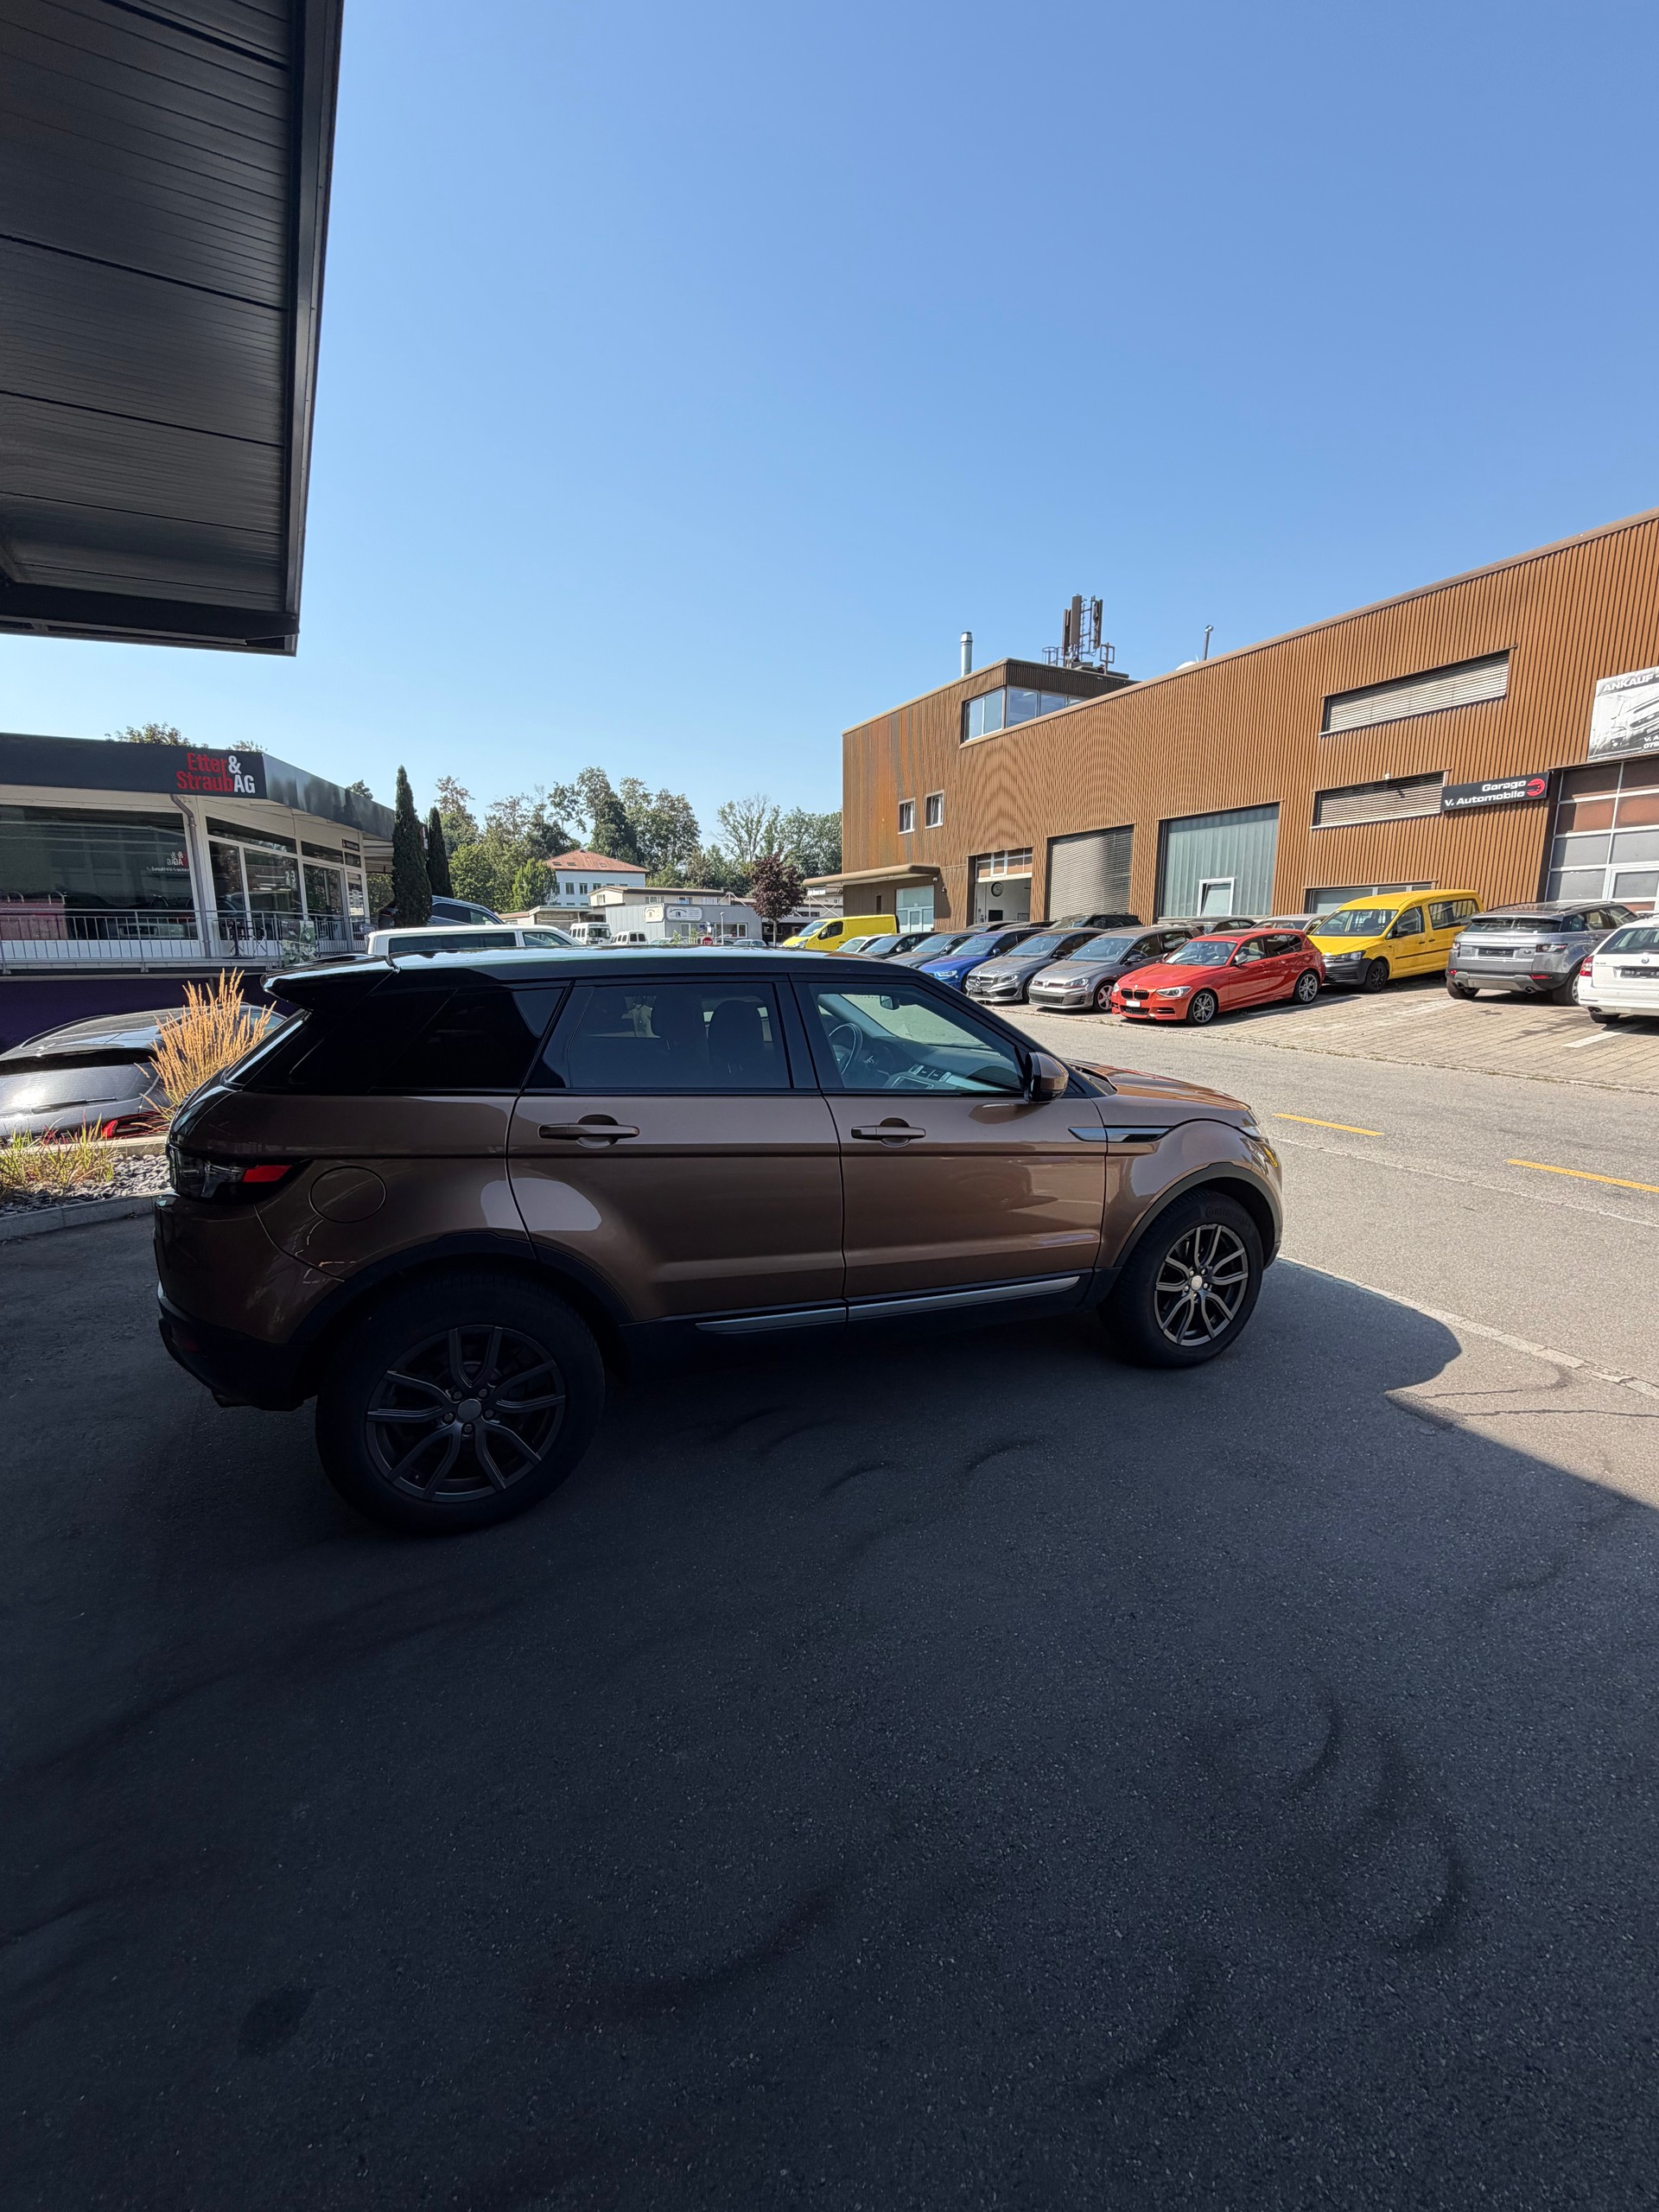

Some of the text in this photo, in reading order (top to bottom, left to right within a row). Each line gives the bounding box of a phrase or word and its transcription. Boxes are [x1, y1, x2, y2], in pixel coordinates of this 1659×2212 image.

[1602, 673, 1655, 692] ANKAUF
[187, 753, 242, 774] Etter &
[176, 771, 256, 793] Straub AG
[1482, 780, 1527, 792] Garage
[1456, 790, 1526, 805] Automobile
